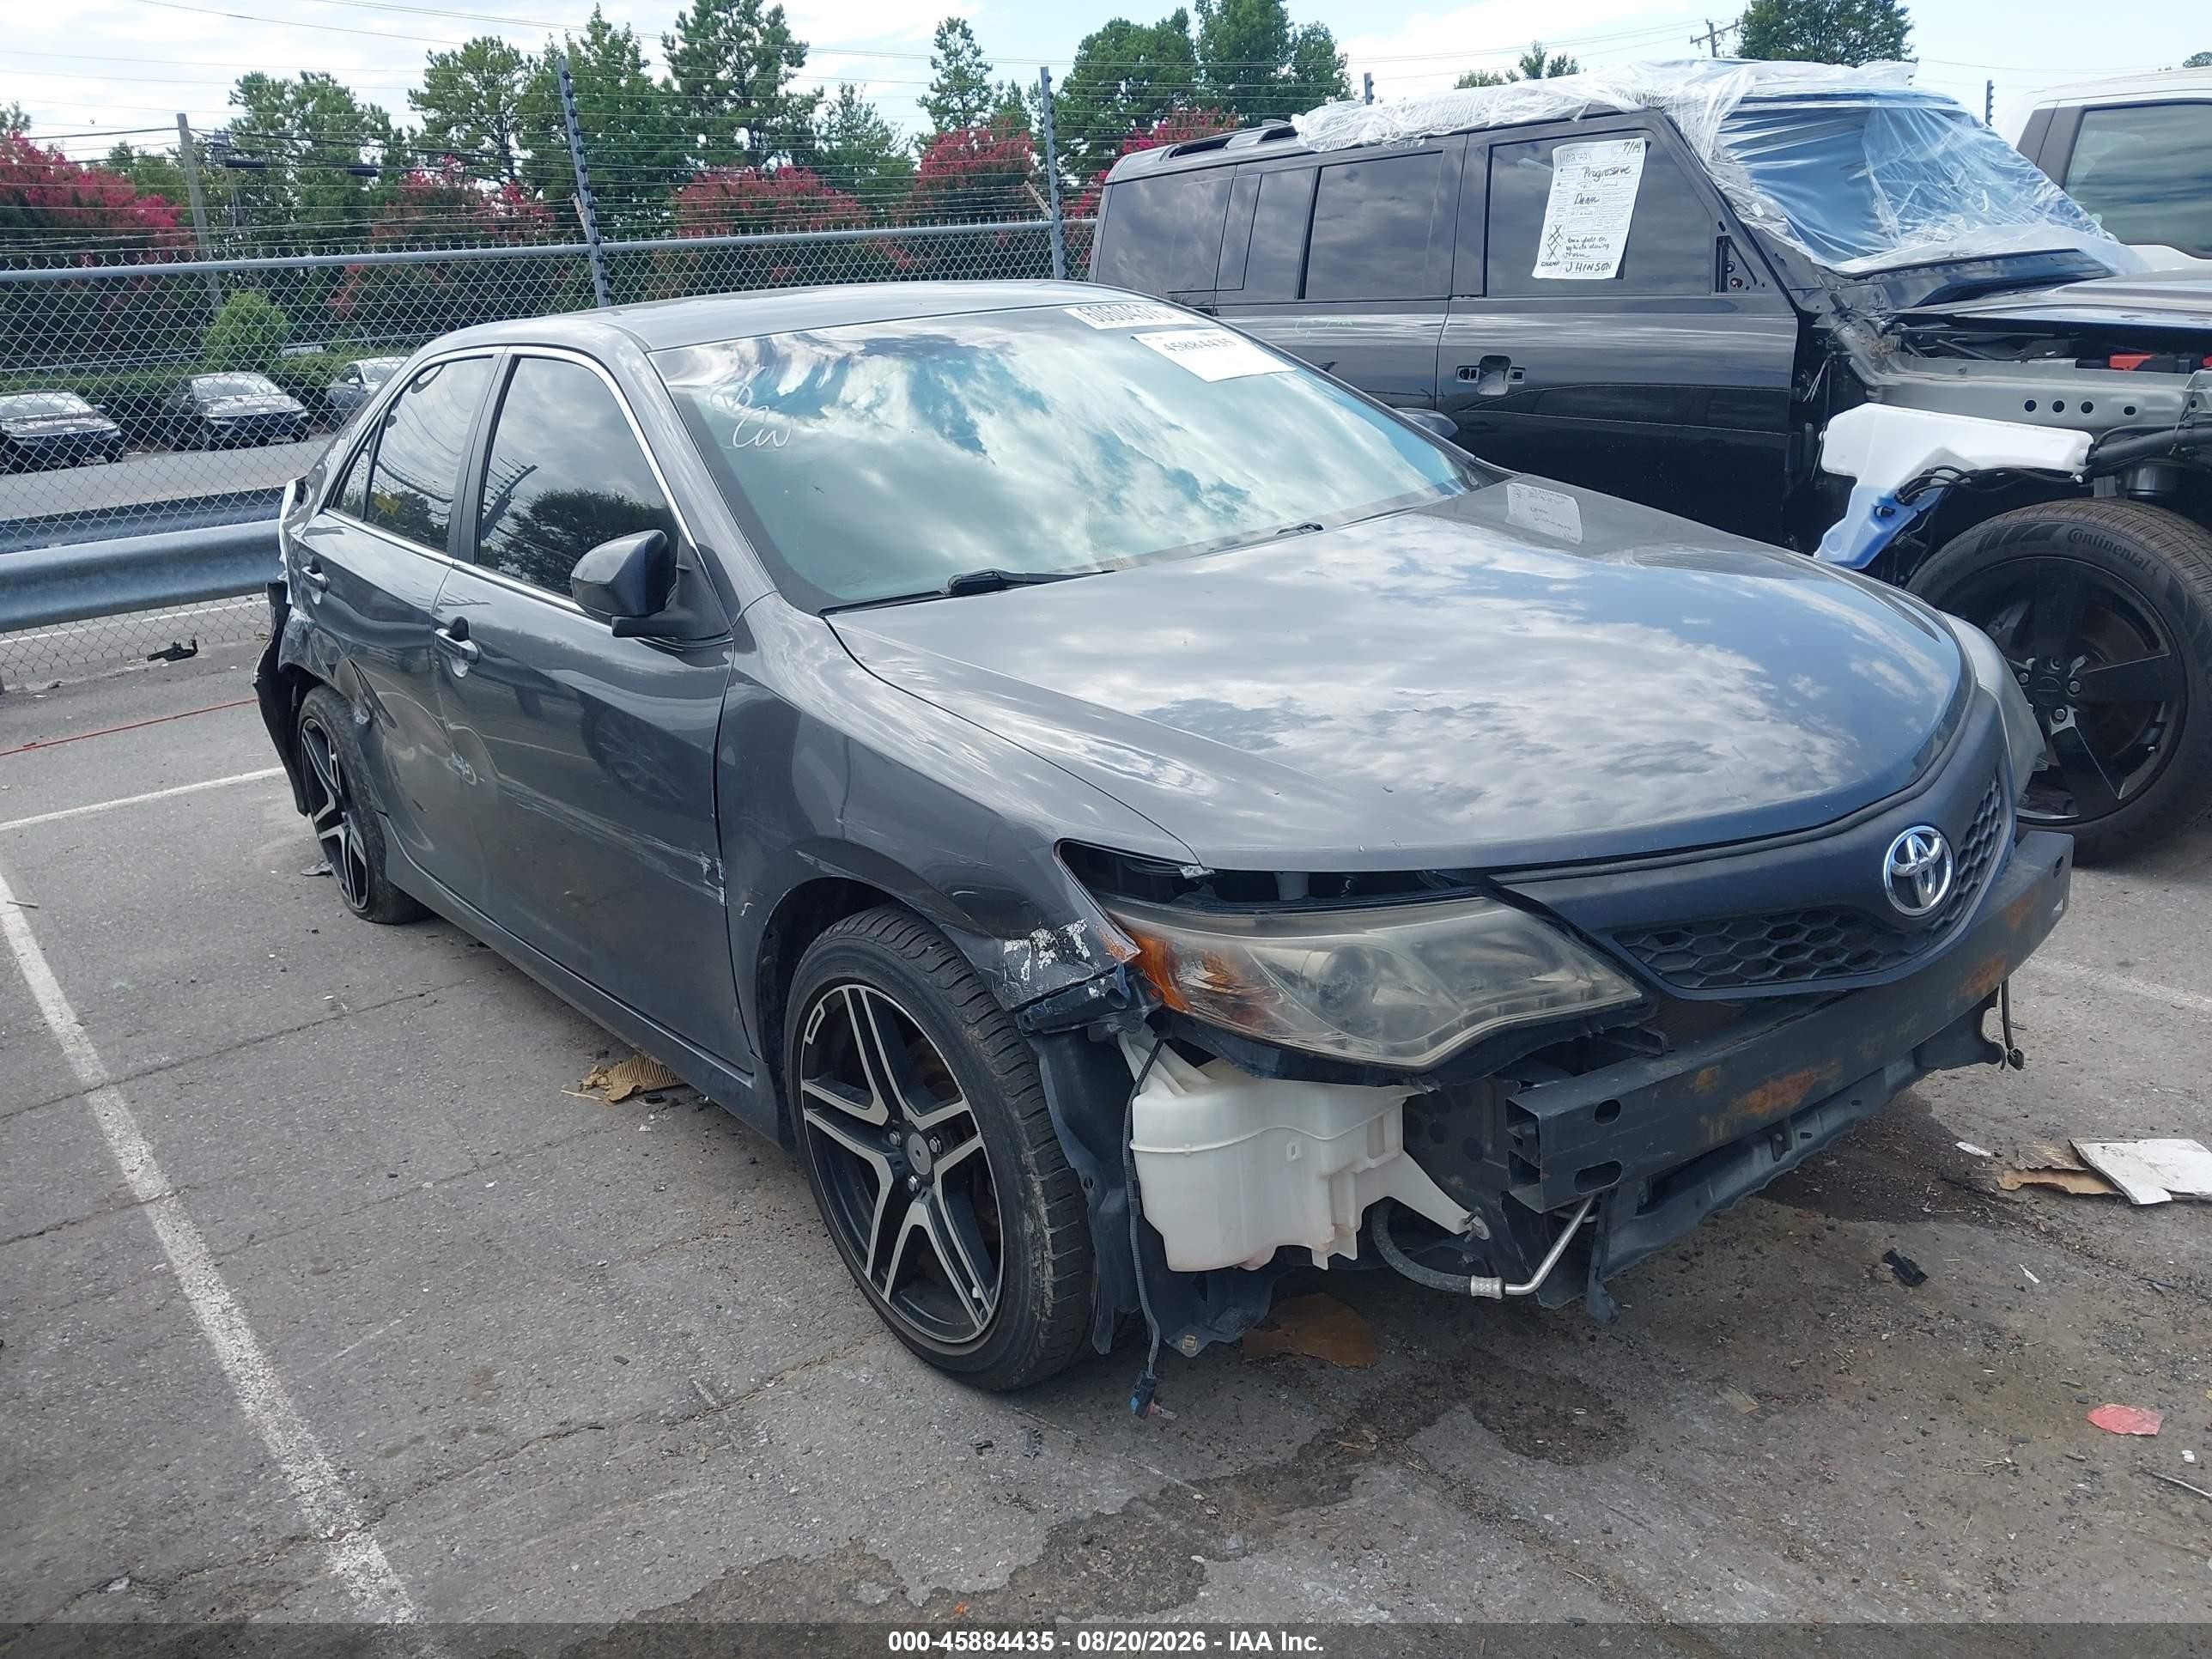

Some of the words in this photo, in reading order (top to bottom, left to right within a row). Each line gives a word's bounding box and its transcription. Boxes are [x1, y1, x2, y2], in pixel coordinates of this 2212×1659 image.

[1582, 165, 1632, 182] Progressive
[1163, 337, 1237, 353] 45884435
[2066, 527, 2151, 571] Continental
